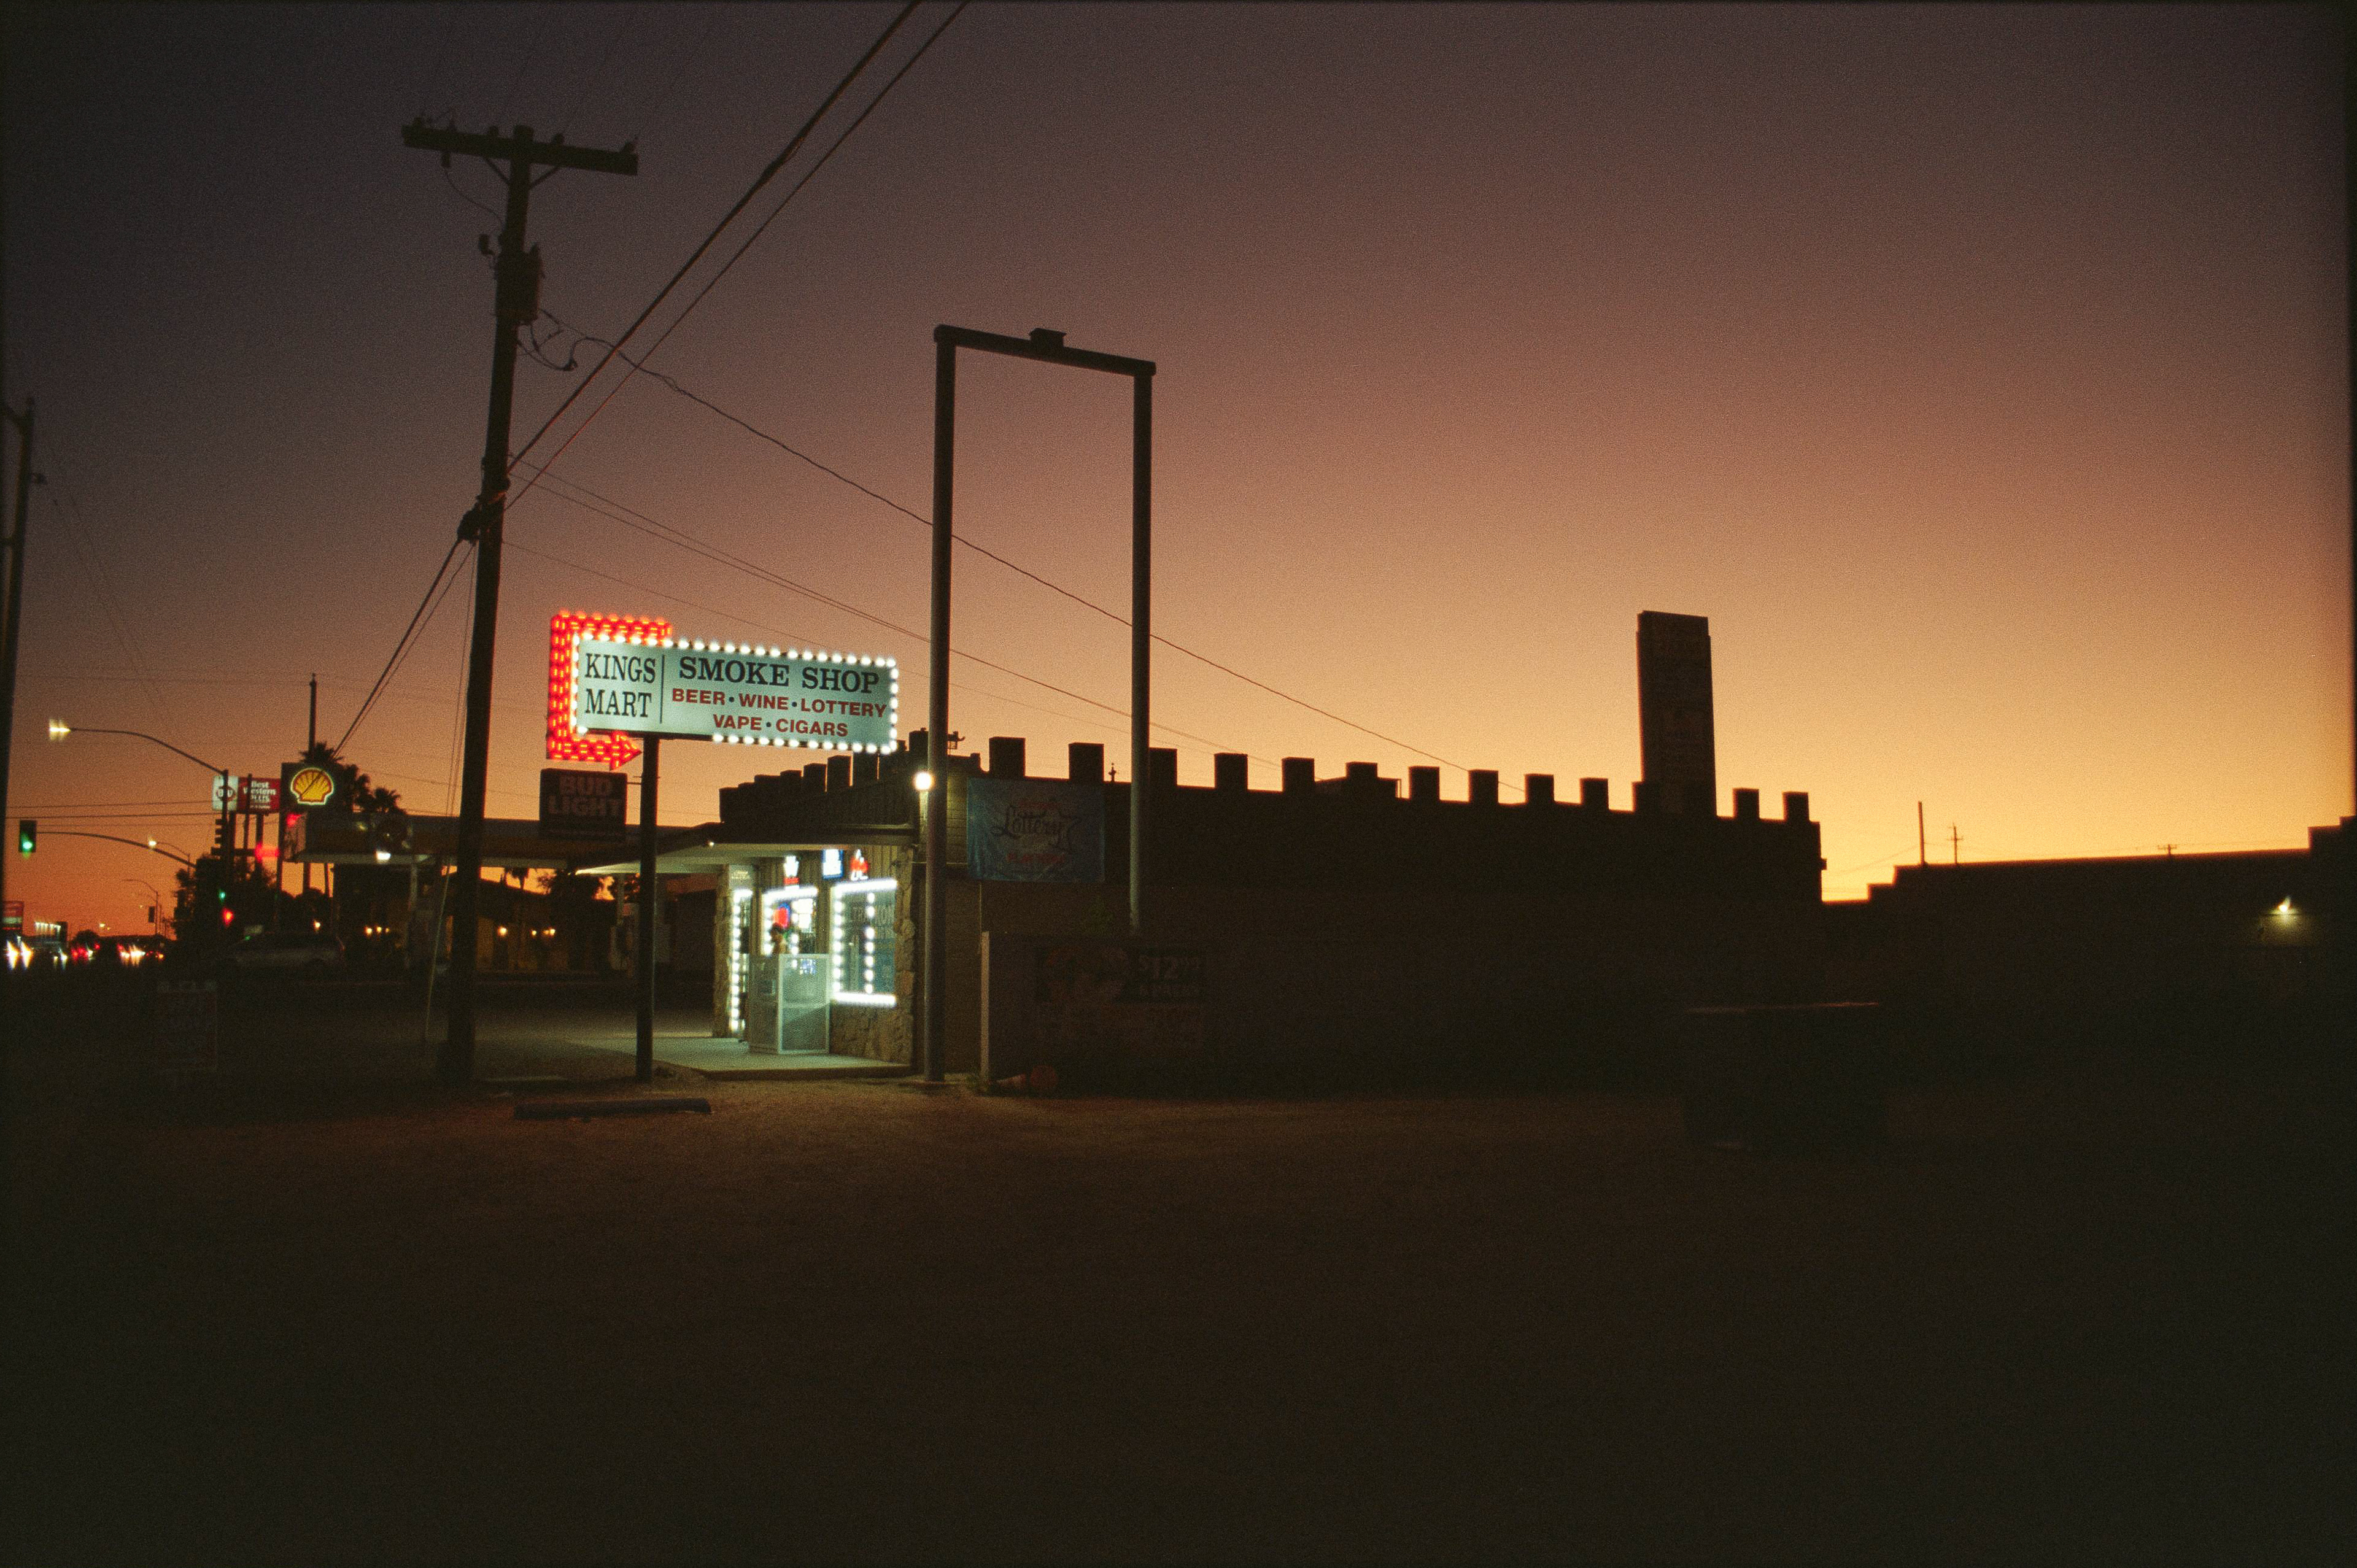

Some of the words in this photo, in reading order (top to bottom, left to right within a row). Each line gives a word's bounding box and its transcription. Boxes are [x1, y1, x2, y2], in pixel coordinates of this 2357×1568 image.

[585, 653, 656, 683] KINGS
[679, 657, 790, 686] SMOKE
[802, 667, 880, 693] SHOP
[585, 688, 652, 717] MART
[672, 688, 726, 705] BEER
[738, 693, 789, 710] WINE
[800, 698, 887, 718] LOTTERY
[713, 714, 762, 731] VAPE
[775, 718, 848, 737] CIGARS
[559, 774, 613, 796] BUD
[548, 795, 622, 816] LIGHT
